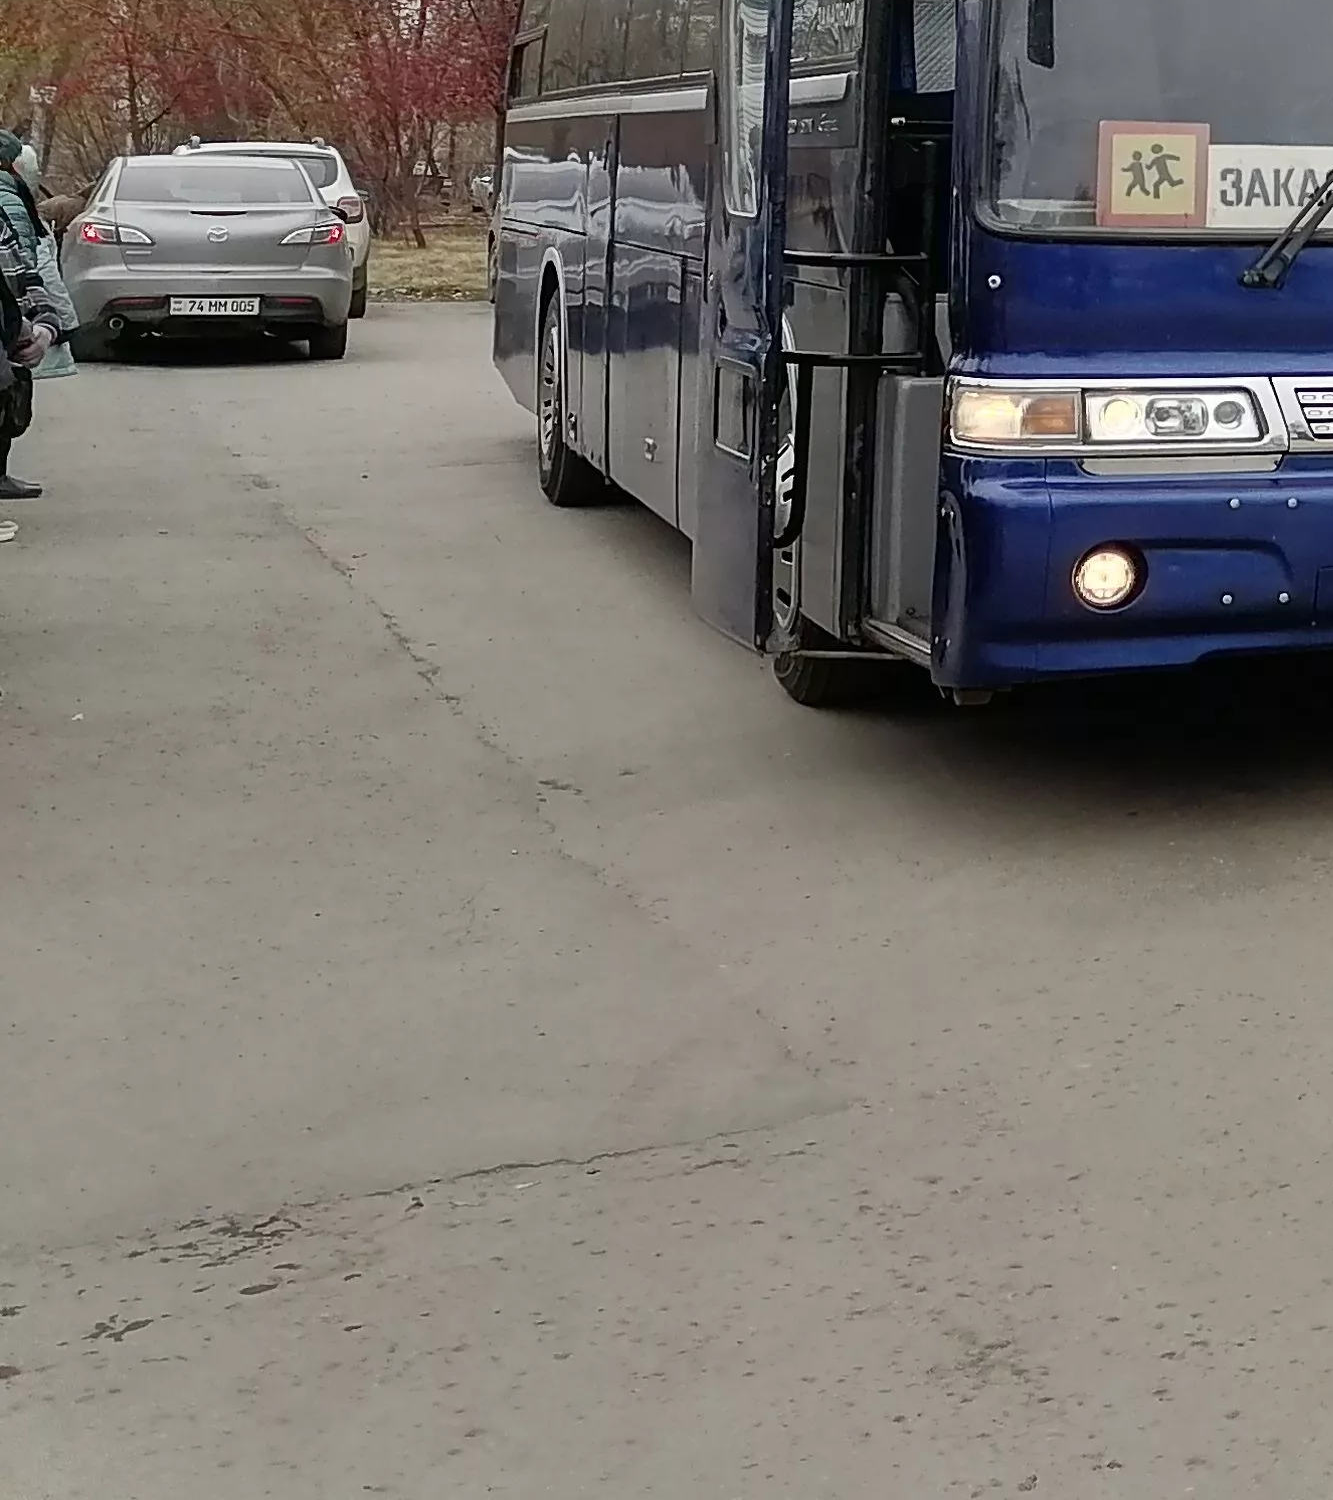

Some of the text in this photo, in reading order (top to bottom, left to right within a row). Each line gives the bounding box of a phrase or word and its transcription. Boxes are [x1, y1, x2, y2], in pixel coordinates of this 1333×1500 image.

[188, 300, 204, 313] 74
[208, 300, 227, 313] MM
[230, 300, 254, 313] 005
